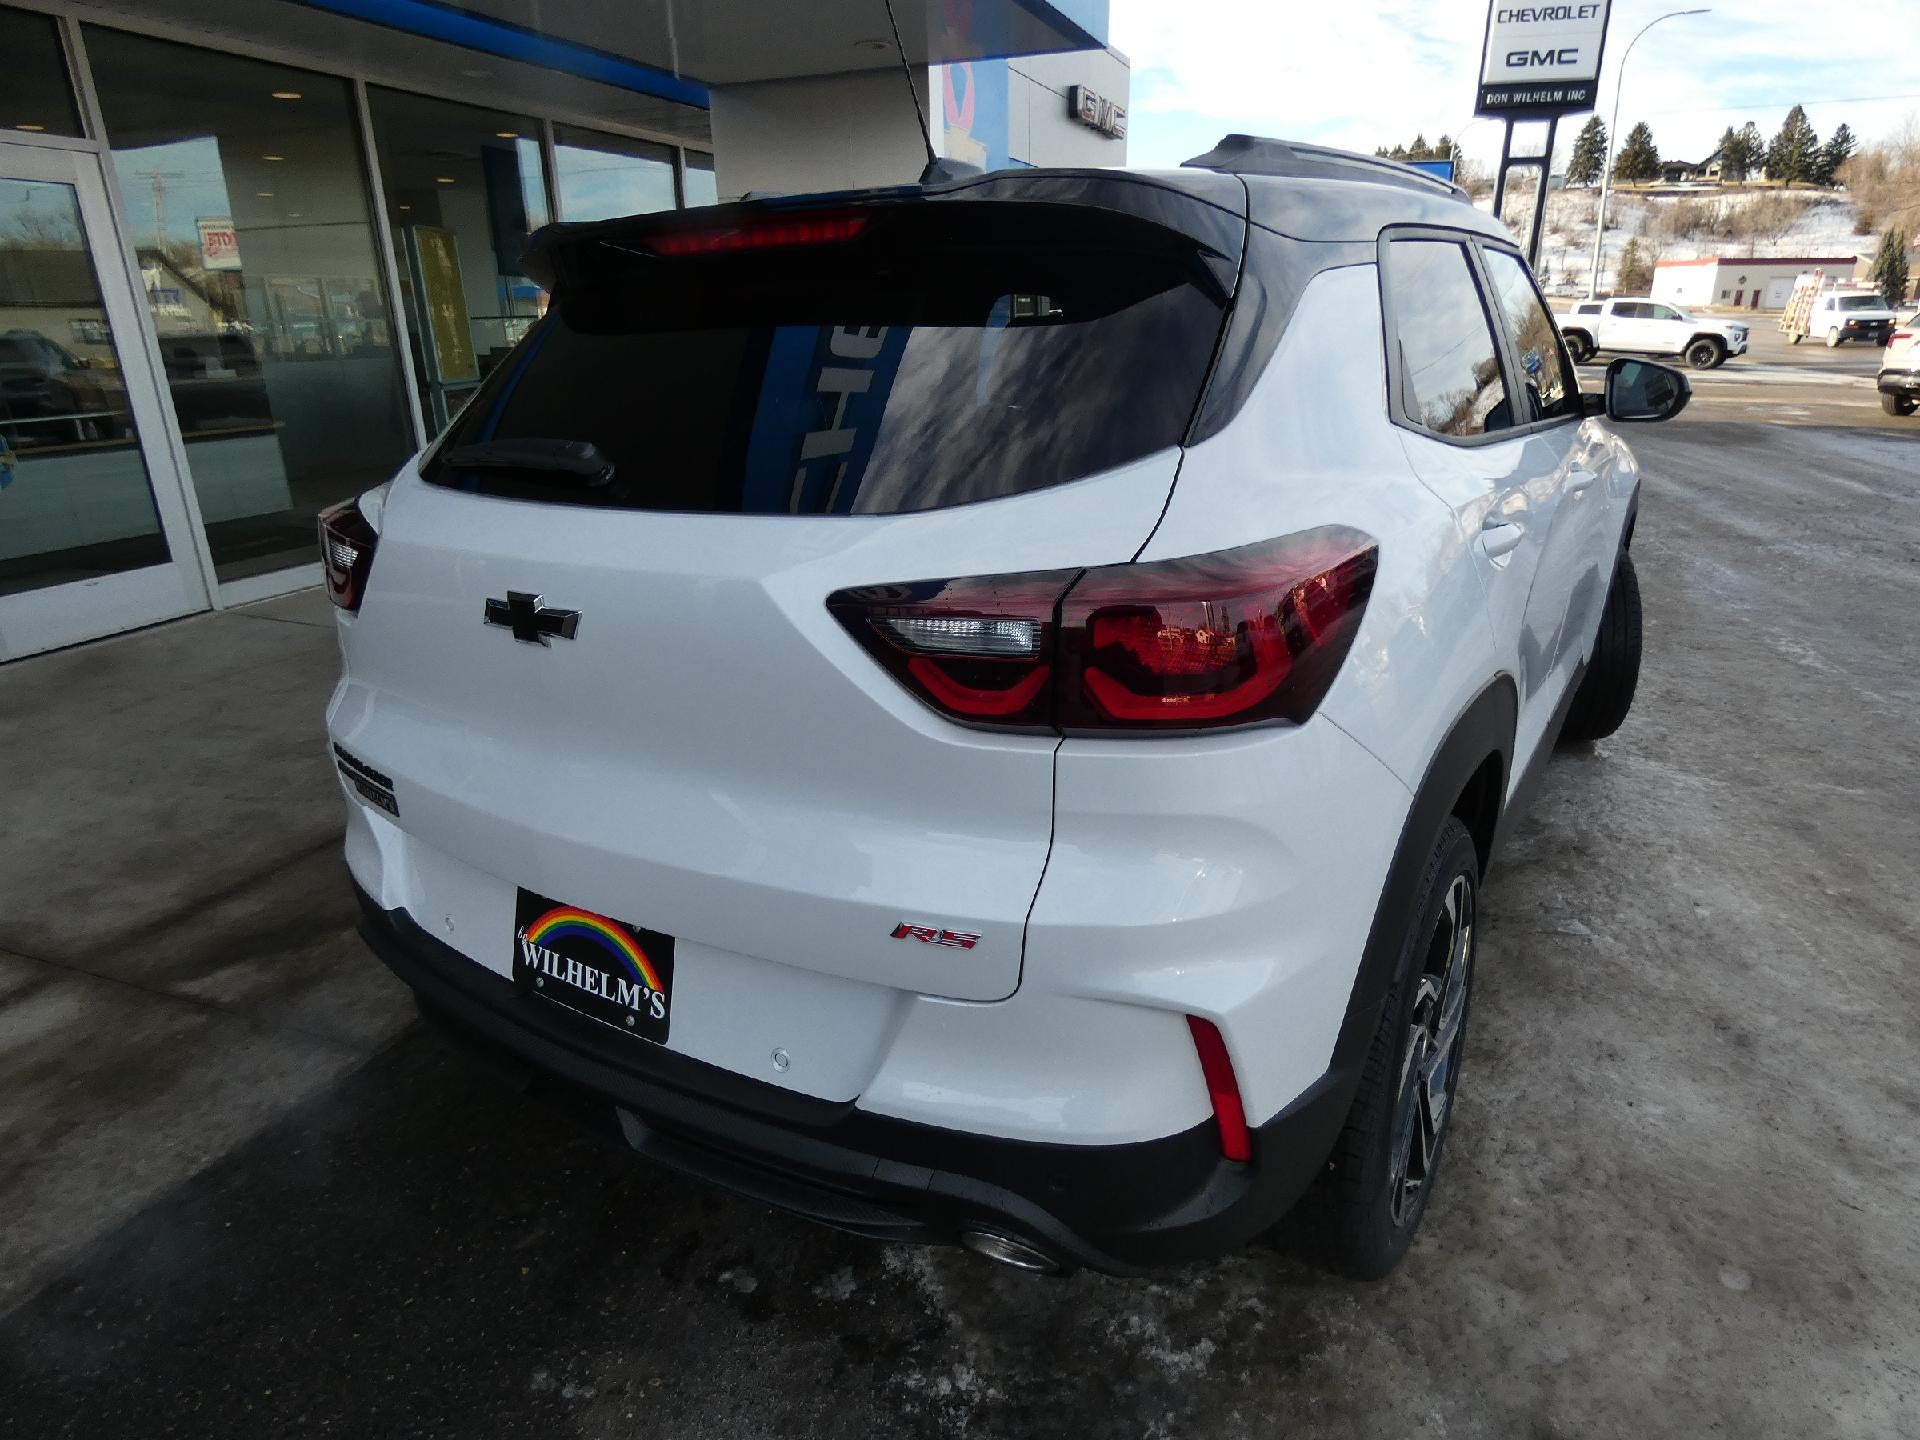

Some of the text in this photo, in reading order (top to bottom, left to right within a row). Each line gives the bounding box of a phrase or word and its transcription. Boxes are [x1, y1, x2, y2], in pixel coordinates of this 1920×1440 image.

[1498, 4, 1600, 23] CHEVROLET
[1506, 48, 1579, 67] GMC
[1487, 89, 1586, 104] DON WILHELM INC
[1080, 86, 1126, 139] GMC
[890, 920, 982, 950] RS
[521, 941, 666, 1020] WILHELM'S
